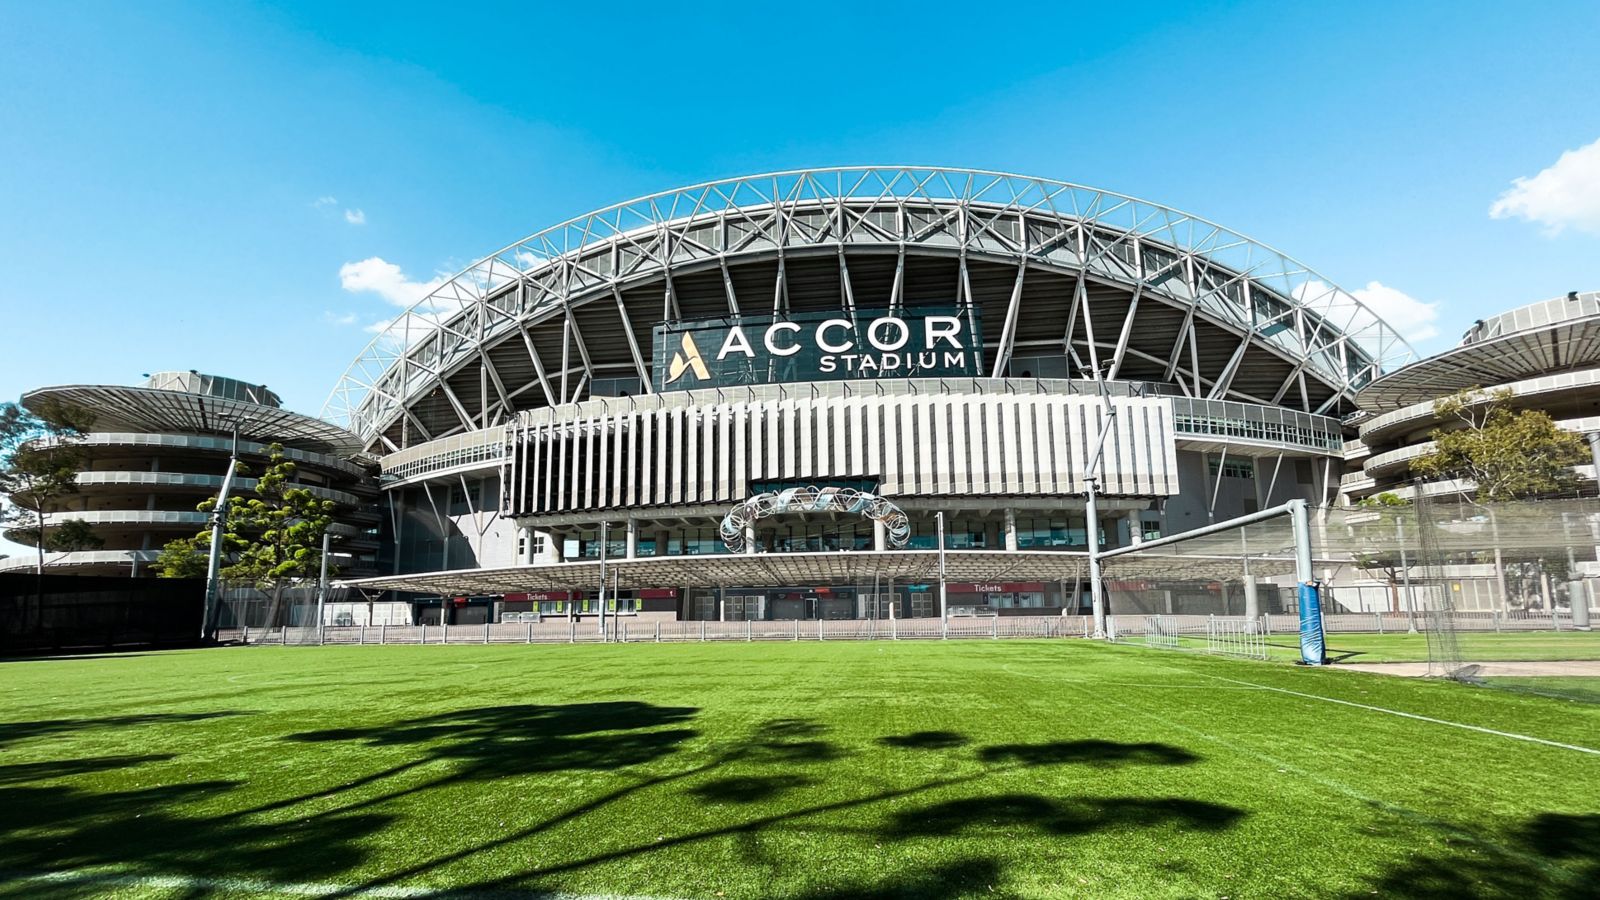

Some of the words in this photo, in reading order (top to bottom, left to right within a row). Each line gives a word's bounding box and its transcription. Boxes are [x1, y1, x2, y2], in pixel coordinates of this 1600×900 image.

[716, 316, 963, 360] ACCOR
[818, 351, 965, 373] STADIUM
[974, 584, 1002, 592] Tickets
[527, 593, 548, 601] Tickets
